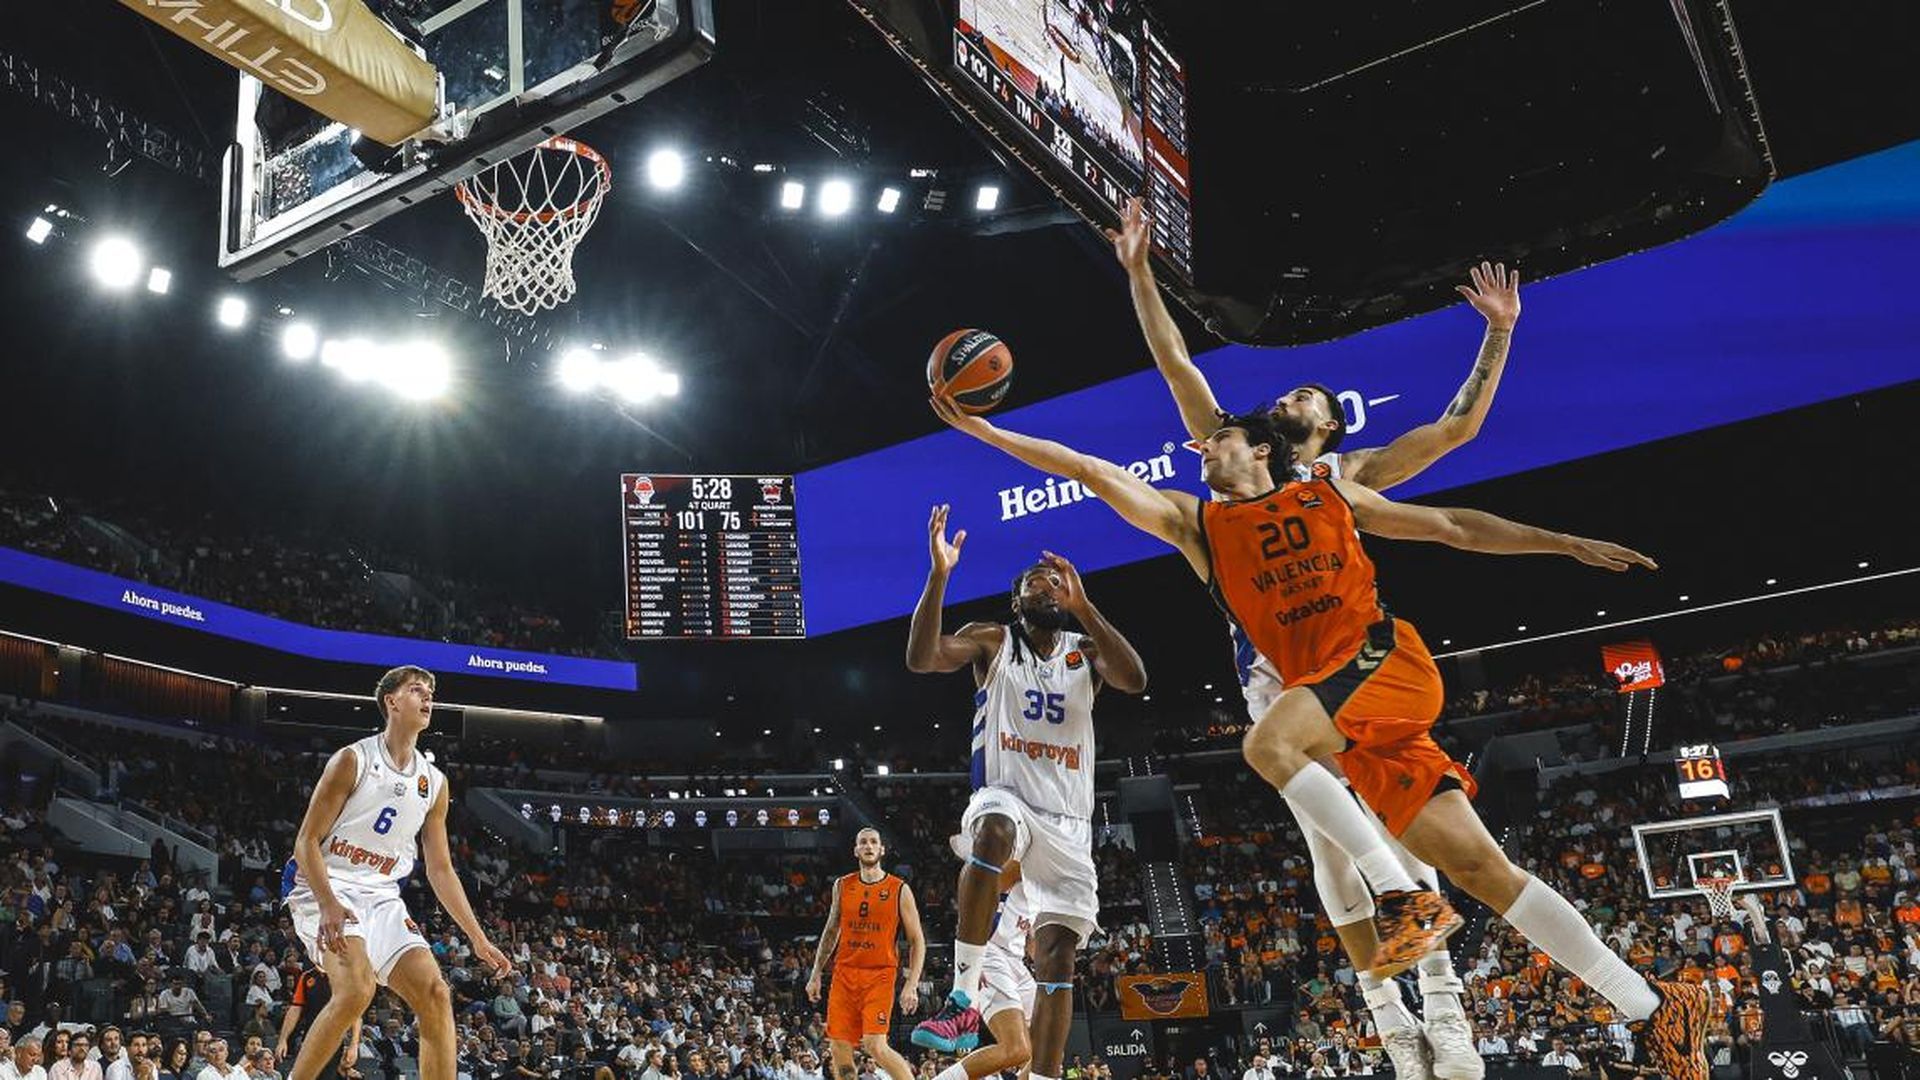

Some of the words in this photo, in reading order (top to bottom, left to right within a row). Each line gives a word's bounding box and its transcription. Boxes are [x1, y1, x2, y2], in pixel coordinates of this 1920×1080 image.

[970, 54, 987, 84] 101
[993, 75, 1000, 93] F
[1000, 83, 1008, 102] 4
[1014, 95, 1030, 125] TM
[1103, 178, 1117, 205] TM
[692, 478, 732, 500] 5:28
[676, 511, 704, 530] 101
[720, 511, 741, 530] 75
[701, 502, 731, 511] QUART
[1257, 515, 1311, 561] 20
[1252, 552, 1344, 594] VALENCIA
[122, 590, 160, 610] Ahora
[161, 602, 205, 622] puedes.
[467, 654, 504, 669] Ahora
[504, 660, 548, 675] puedes.
[1023, 689, 1066, 725] 35
[1000, 732, 1081, 770] kingroyal
[1681, 760, 1714, 781] 16
[373, 806, 398, 836] 6
[329, 835, 400, 876] kingroyal
[1105, 1043, 1148, 1057] SALIDA
